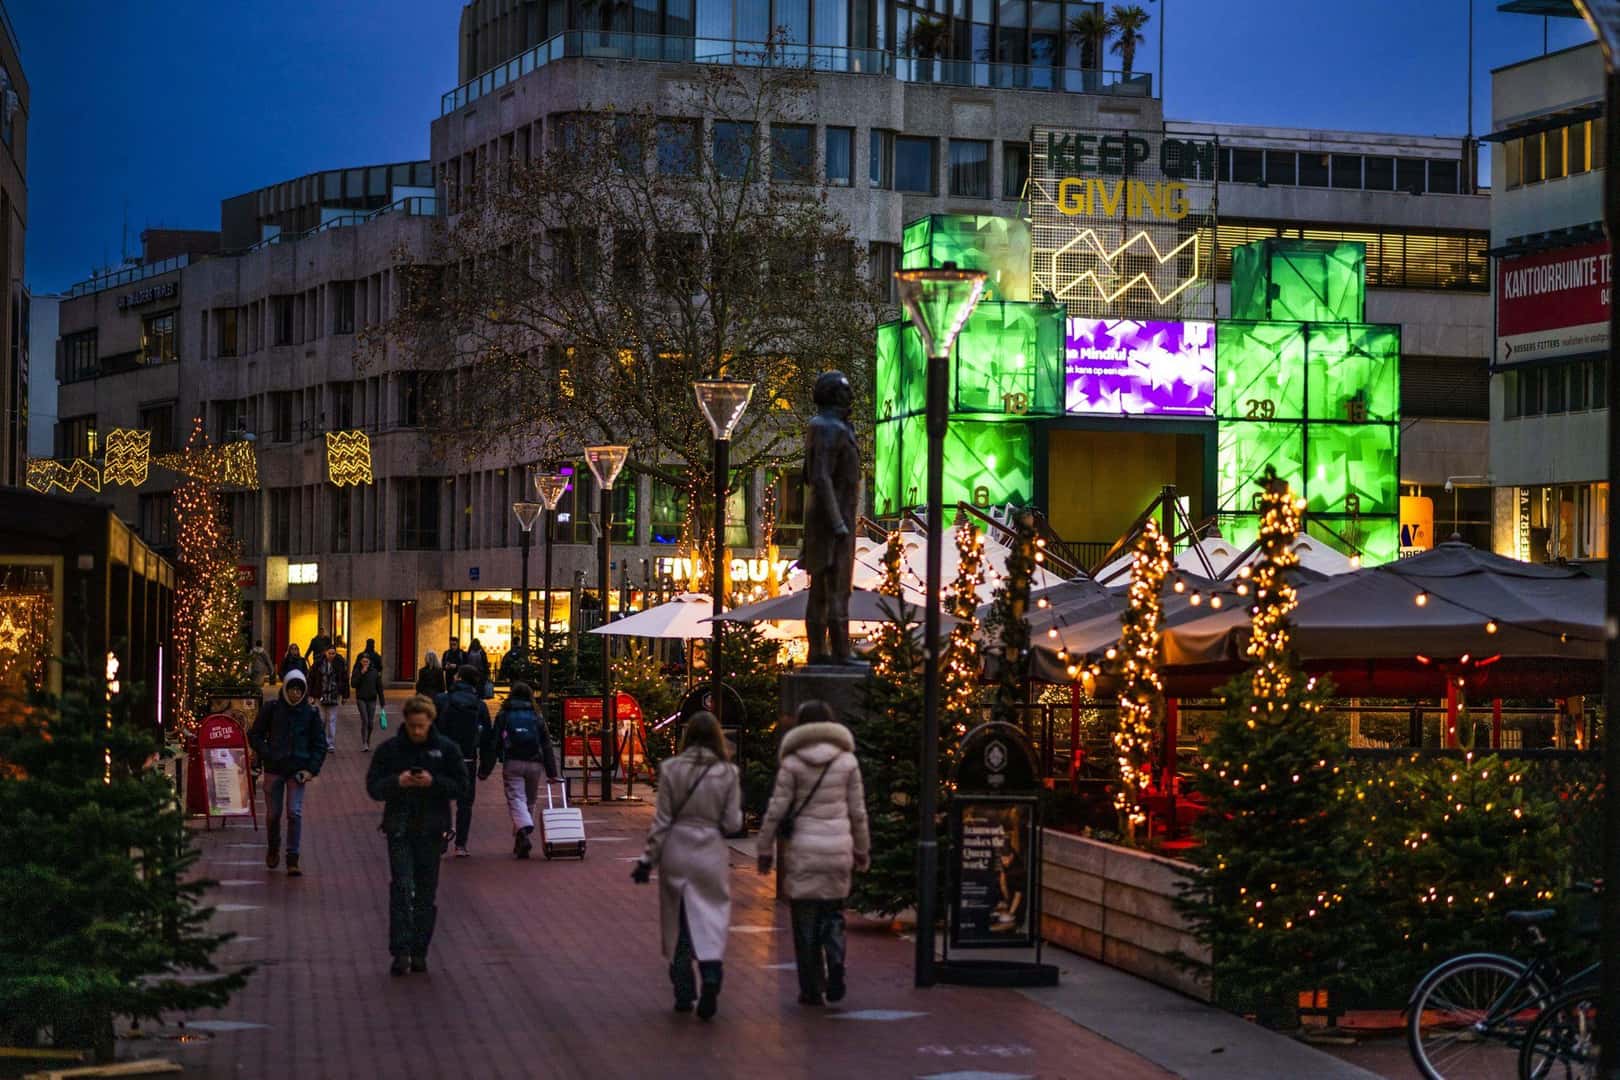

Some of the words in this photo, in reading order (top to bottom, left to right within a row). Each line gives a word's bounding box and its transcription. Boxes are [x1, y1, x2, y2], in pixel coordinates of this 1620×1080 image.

[1047, 130, 1150, 176] KEEP
[1159, 137, 1214, 180] ON
[1057, 176, 1190, 221] GIVING
[1505, 255, 1598, 300] KANTOORRUIMTE
[1080, 346, 1126, 361] Mindful
[1245, 393, 1276, 421] 29
[974, 485, 990, 508] 6
